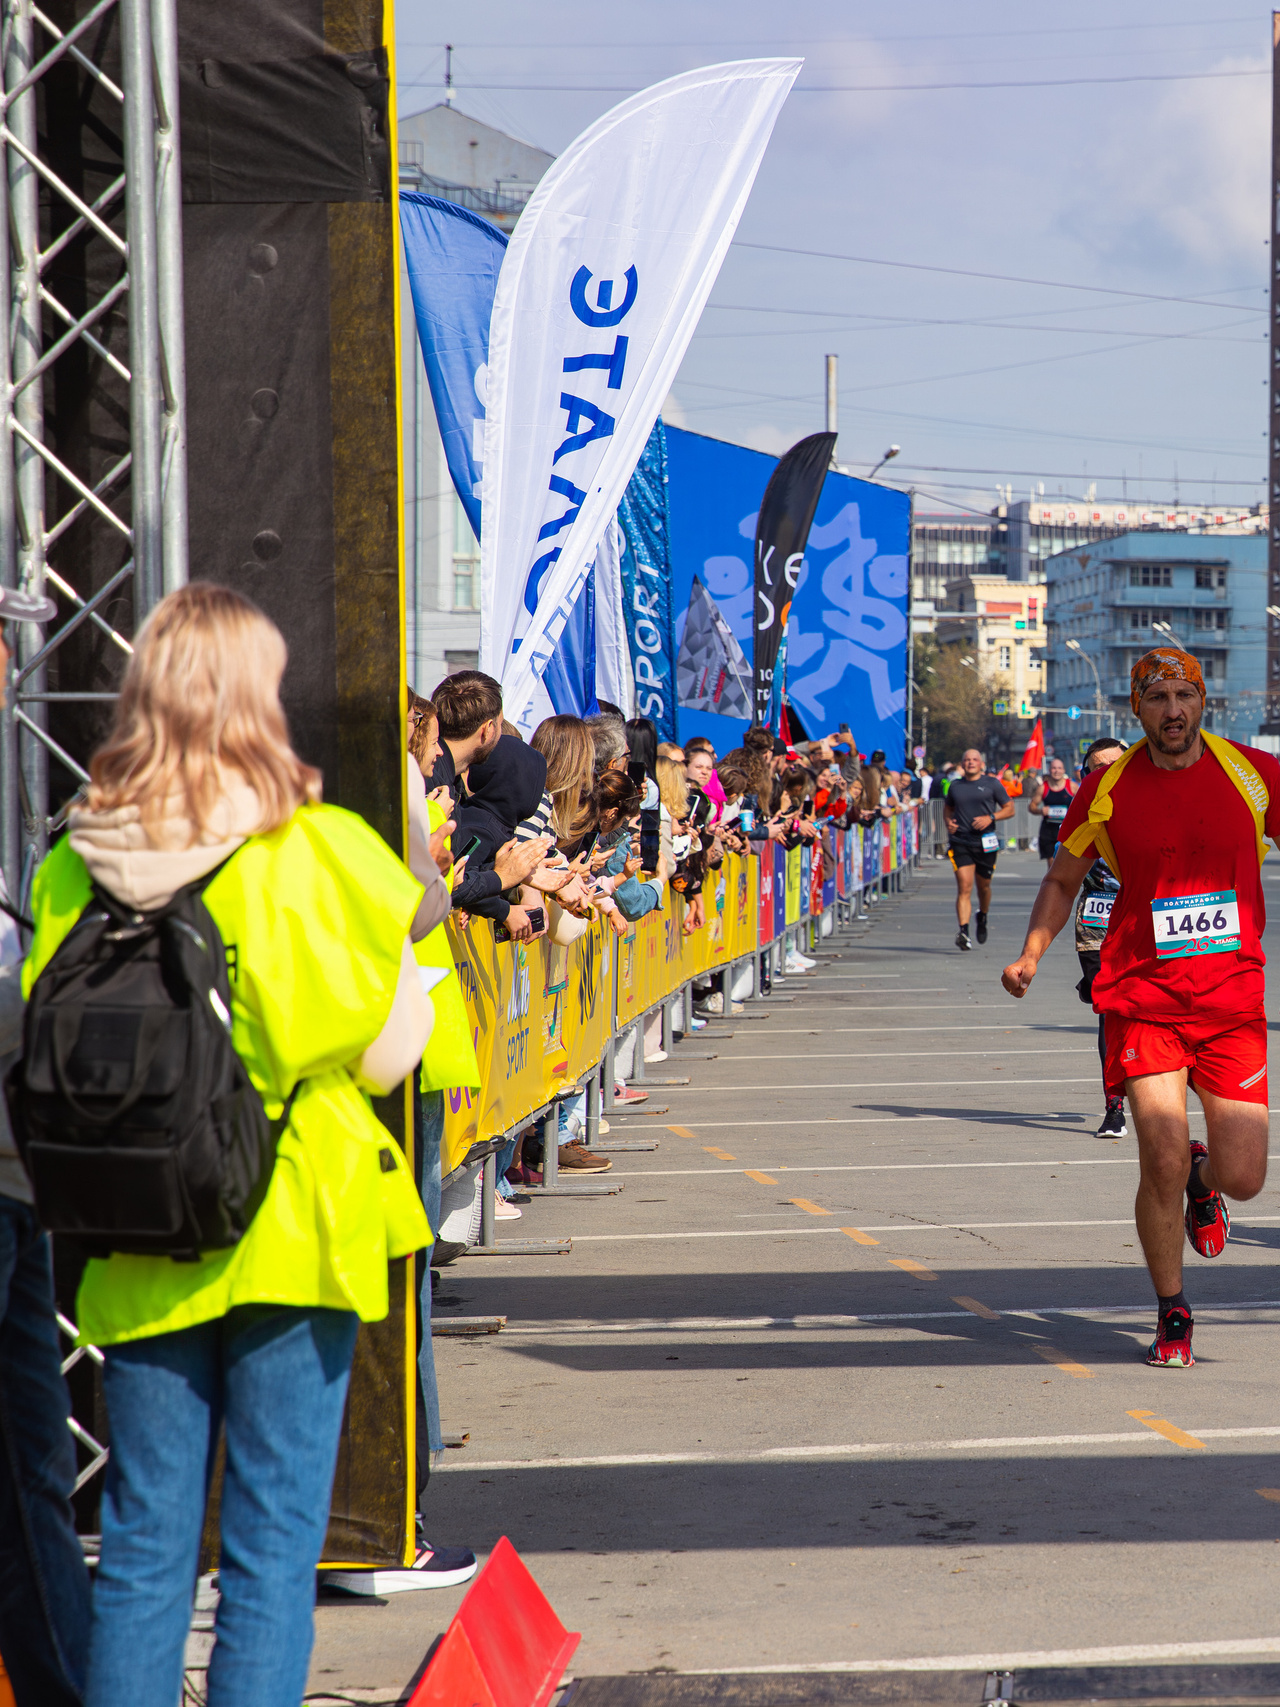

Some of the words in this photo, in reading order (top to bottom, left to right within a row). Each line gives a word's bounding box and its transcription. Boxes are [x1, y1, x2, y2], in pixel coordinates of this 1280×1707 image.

[634, 550, 664, 718] SPORT
[1089, 901, 1113, 915] 109
[1166, 909, 1227, 936] 1466
[1185, 936, 1210, 954] 26
[506, 1027, 529, 1080] SPORT
